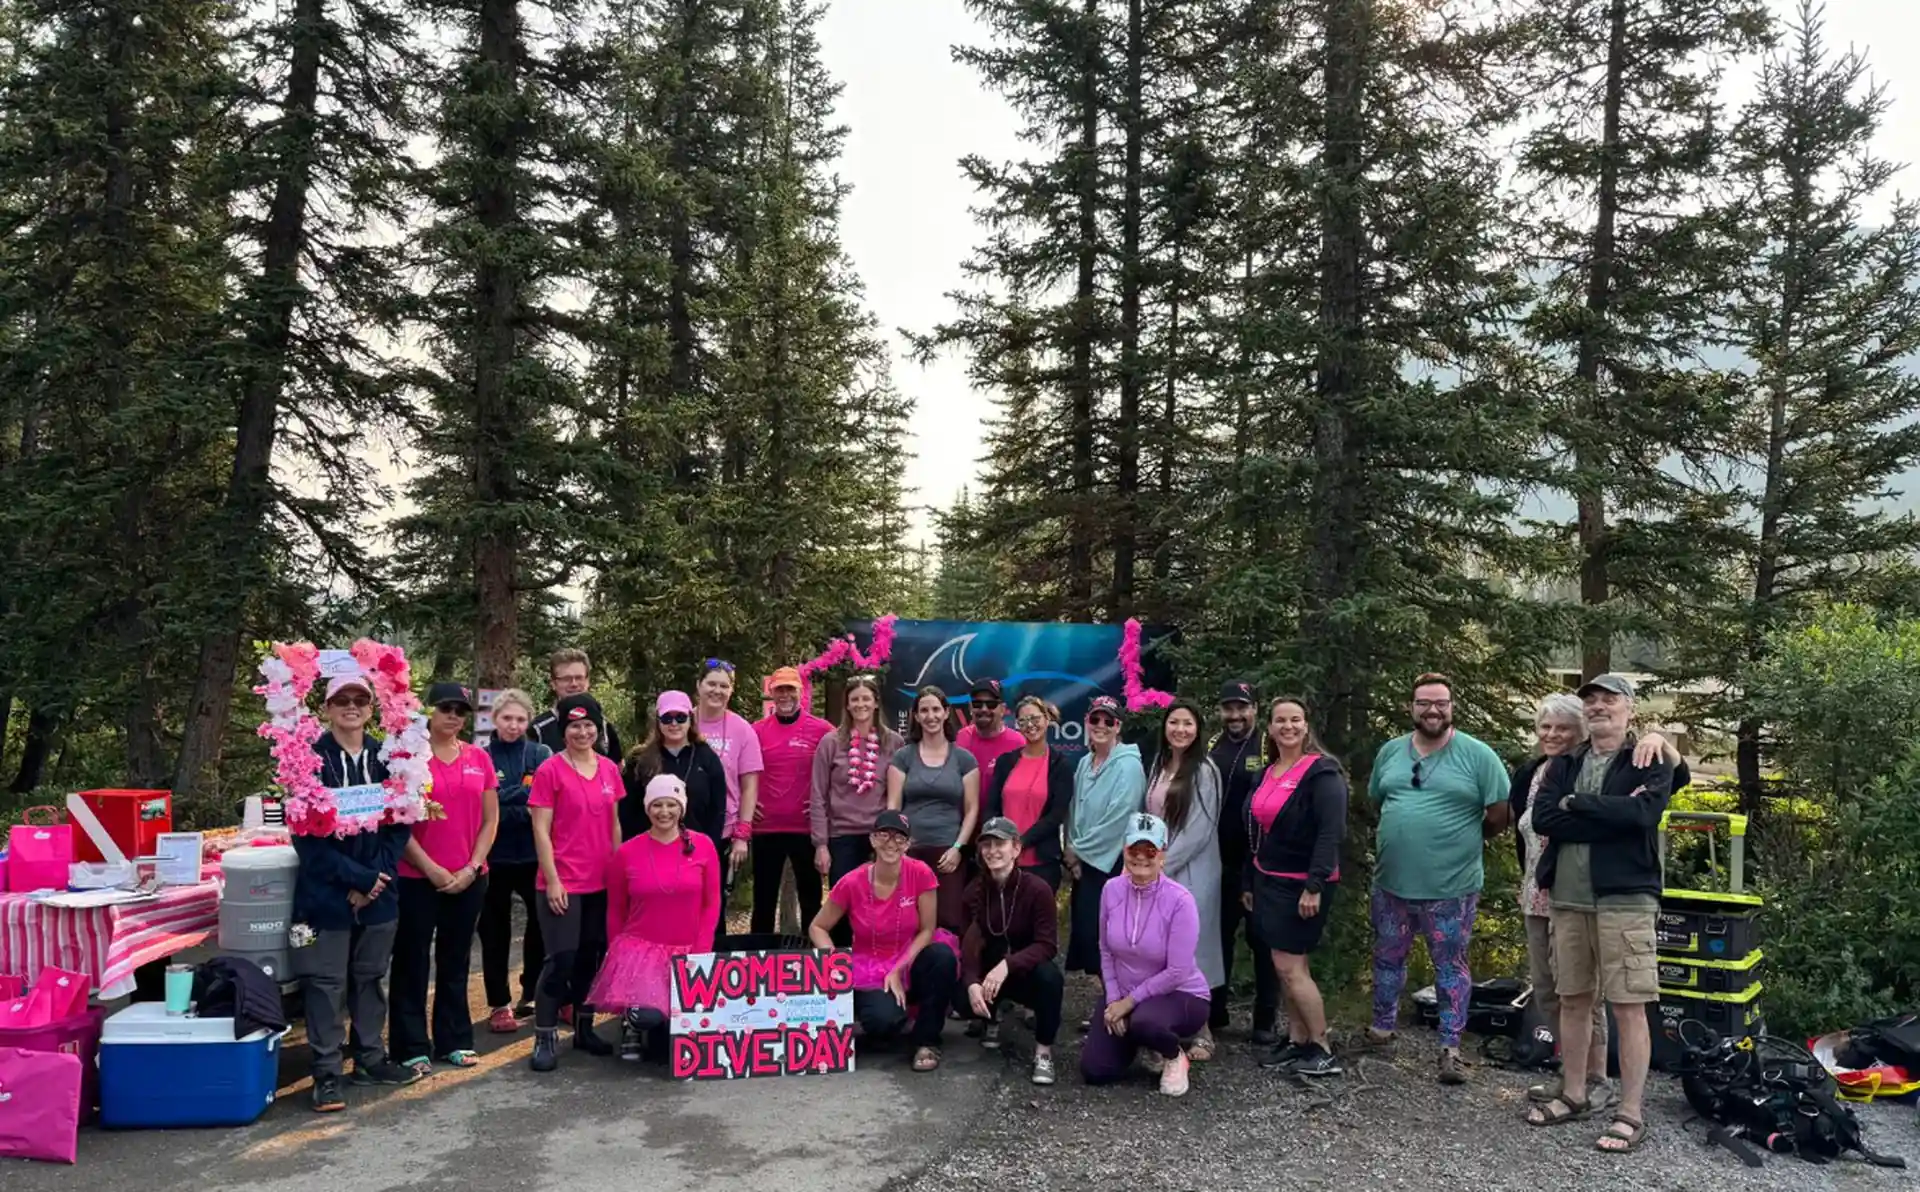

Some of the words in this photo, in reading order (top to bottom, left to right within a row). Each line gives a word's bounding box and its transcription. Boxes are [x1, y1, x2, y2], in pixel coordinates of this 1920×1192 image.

[675, 951, 853, 1010] WOMENS
[673, 1031, 780, 1078] DIVE
[787, 1027, 853, 1073] DAY
